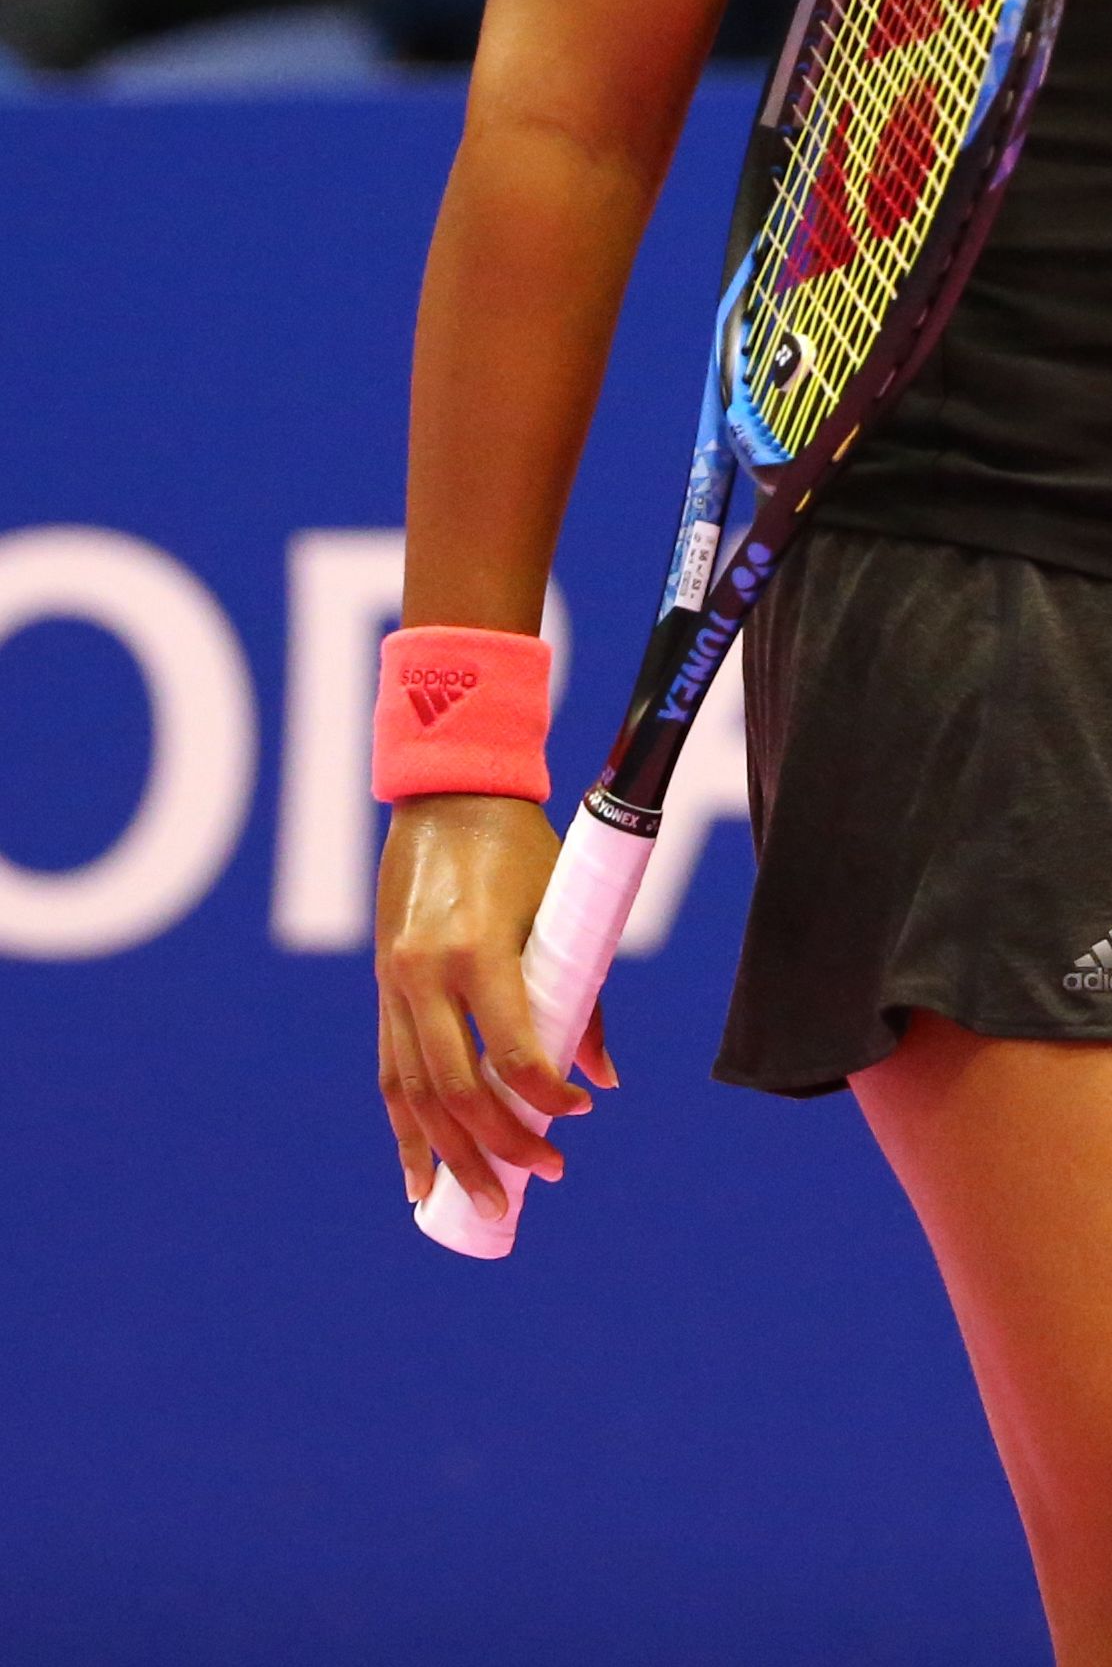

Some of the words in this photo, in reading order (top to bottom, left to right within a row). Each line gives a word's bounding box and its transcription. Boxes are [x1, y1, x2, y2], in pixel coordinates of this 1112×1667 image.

[401, 669, 477, 690] adidas
[657, 609, 738, 723] YONEX
[598, 799, 640, 829] YONEX
